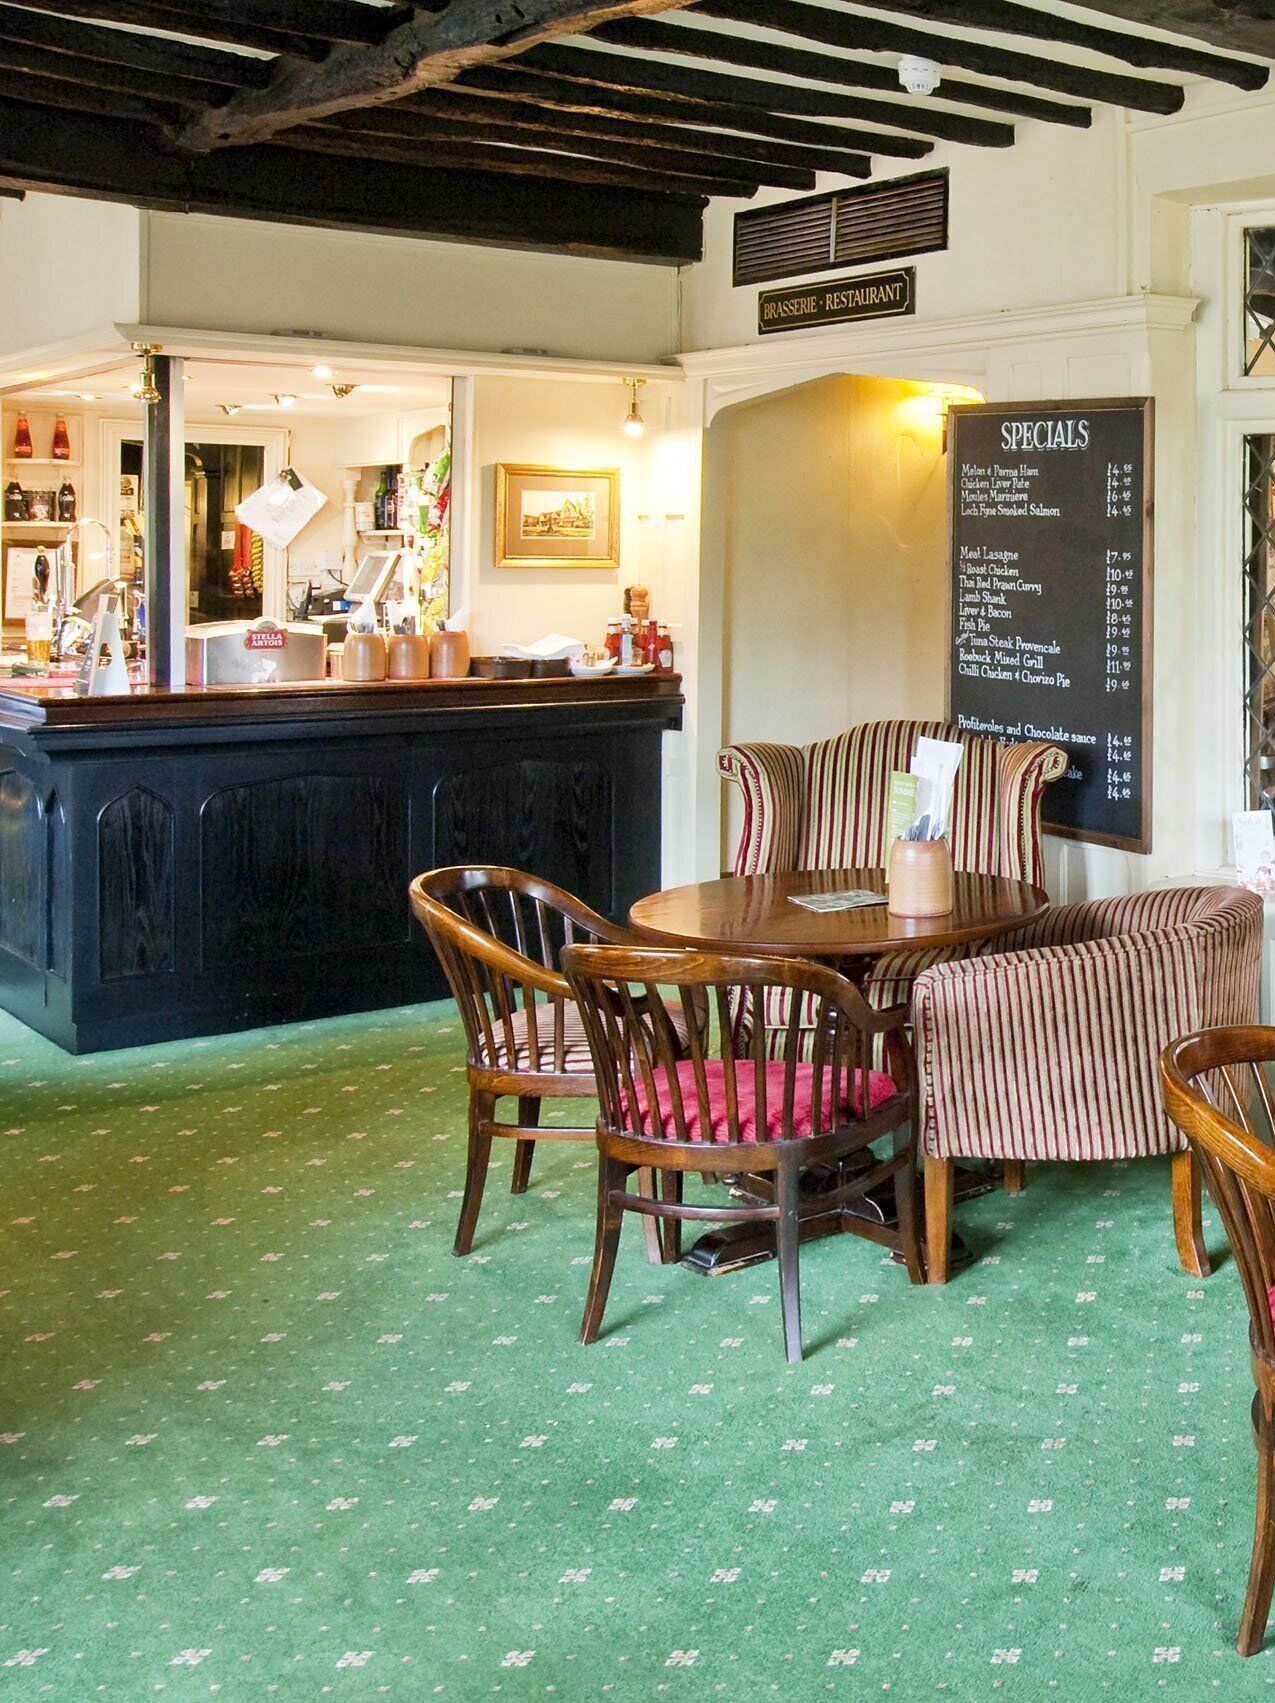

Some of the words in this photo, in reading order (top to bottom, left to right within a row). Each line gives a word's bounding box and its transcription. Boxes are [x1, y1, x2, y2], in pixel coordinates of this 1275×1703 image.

[763, 296, 818, 320] BRASSERIE
[825, 282, 904, 311] RESTAURANT
[1001, 419, 1090, 450] SPECIALS
[961, 464, 985, 477] Melon
[994, 464, 1018, 477] Parma
[1020, 464, 1039, 476] Ham
[961, 478, 989, 489] Chicken
[991, 477, 1011, 489] Liver
[1012, 478, 1030, 489] Pate
[961, 490, 988, 502] Moules
[961, 503, 978, 516] Loch
[979, 503, 997, 518] Fyne
[997, 503, 1028, 516] Smoked
[1029, 503, 1061, 517] Salmon
[960, 546, 982, 559] Meat
[983, 546, 1019, 563] Lasagne
[1106, 549, 1132, 564] £7.95
[967, 563, 987, 575] Roast
[988, 564, 1019, 577] Chicken
[959, 575, 975, 588] Thai
[976, 576, 991, 589] Red
[993, 577, 1016, 591] Prawn
[1016, 580, 1042, 595] Curry
[960, 589, 980, 602] Lamb
[982, 591, 1007, 605] Shank
[959, 603, 979, 616] Liver
[987, 605, 1012, 618] Bacon
[959, 617, 976, 631] Fish
[978, 618, 991, 632] Pie
[251, 633, 283, 641] STELLA
[969, 633, 988, 646] Tuna
[988, 634, 1014, 648] Steak
[1015, 636, 1061, 654] Provencale
[959, 648, 991, 663] Roebuck
[994, 650, 1020, 666] Mixed
[1023, 653, 1044, 669] Grill
[958, 663, 979, 676] Chilli
[981, 664, 1012, 681] Chicken
[1021, 670, 1055, 685] Chorizo
[1056, 672, 1071, 687] Pie
[957, 713, 1004, 734] Profiteroles
[1006, 722, 1021, 735] and
[1024, 723, 1069, 742] Chocolate
[1071, 732, 1097, 745] sauce
